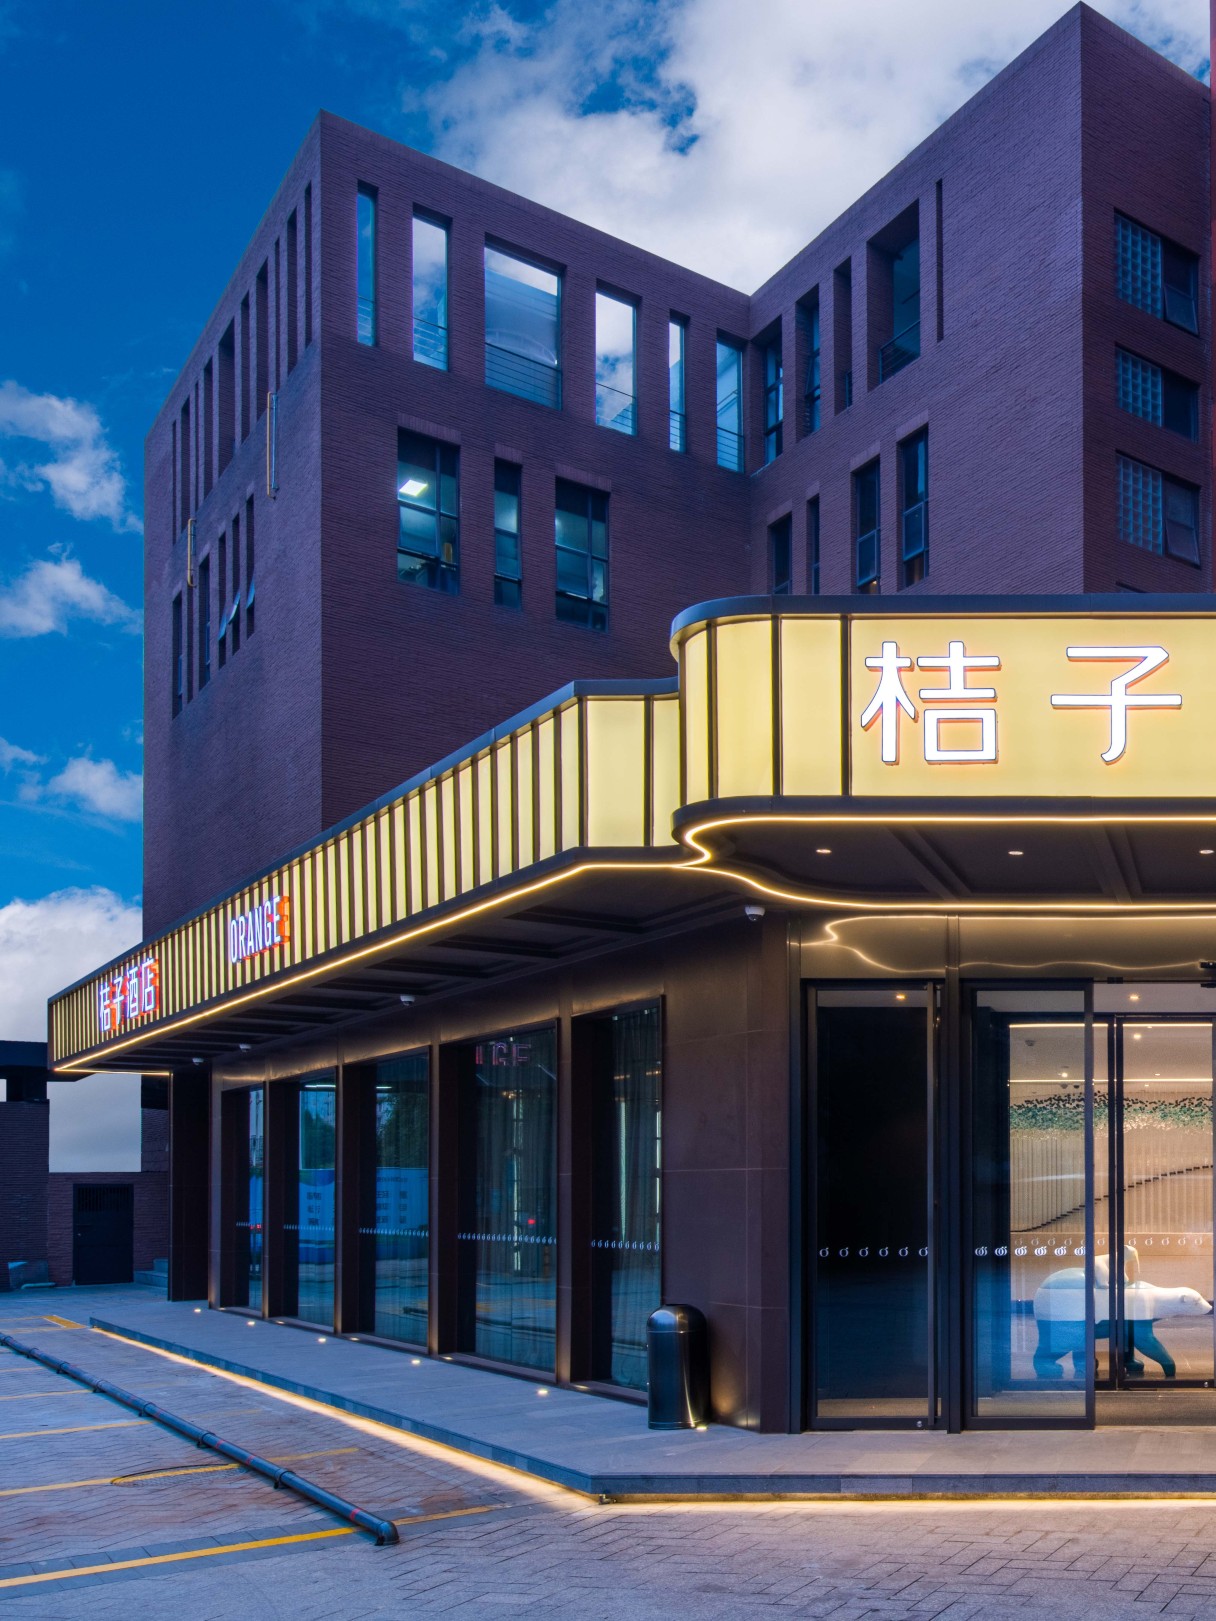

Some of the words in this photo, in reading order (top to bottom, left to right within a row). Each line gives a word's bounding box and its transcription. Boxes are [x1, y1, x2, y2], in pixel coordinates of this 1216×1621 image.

[230, 895, 282, 964] ORANGE
[100, 957, 156, 1032] 桔子酒店
